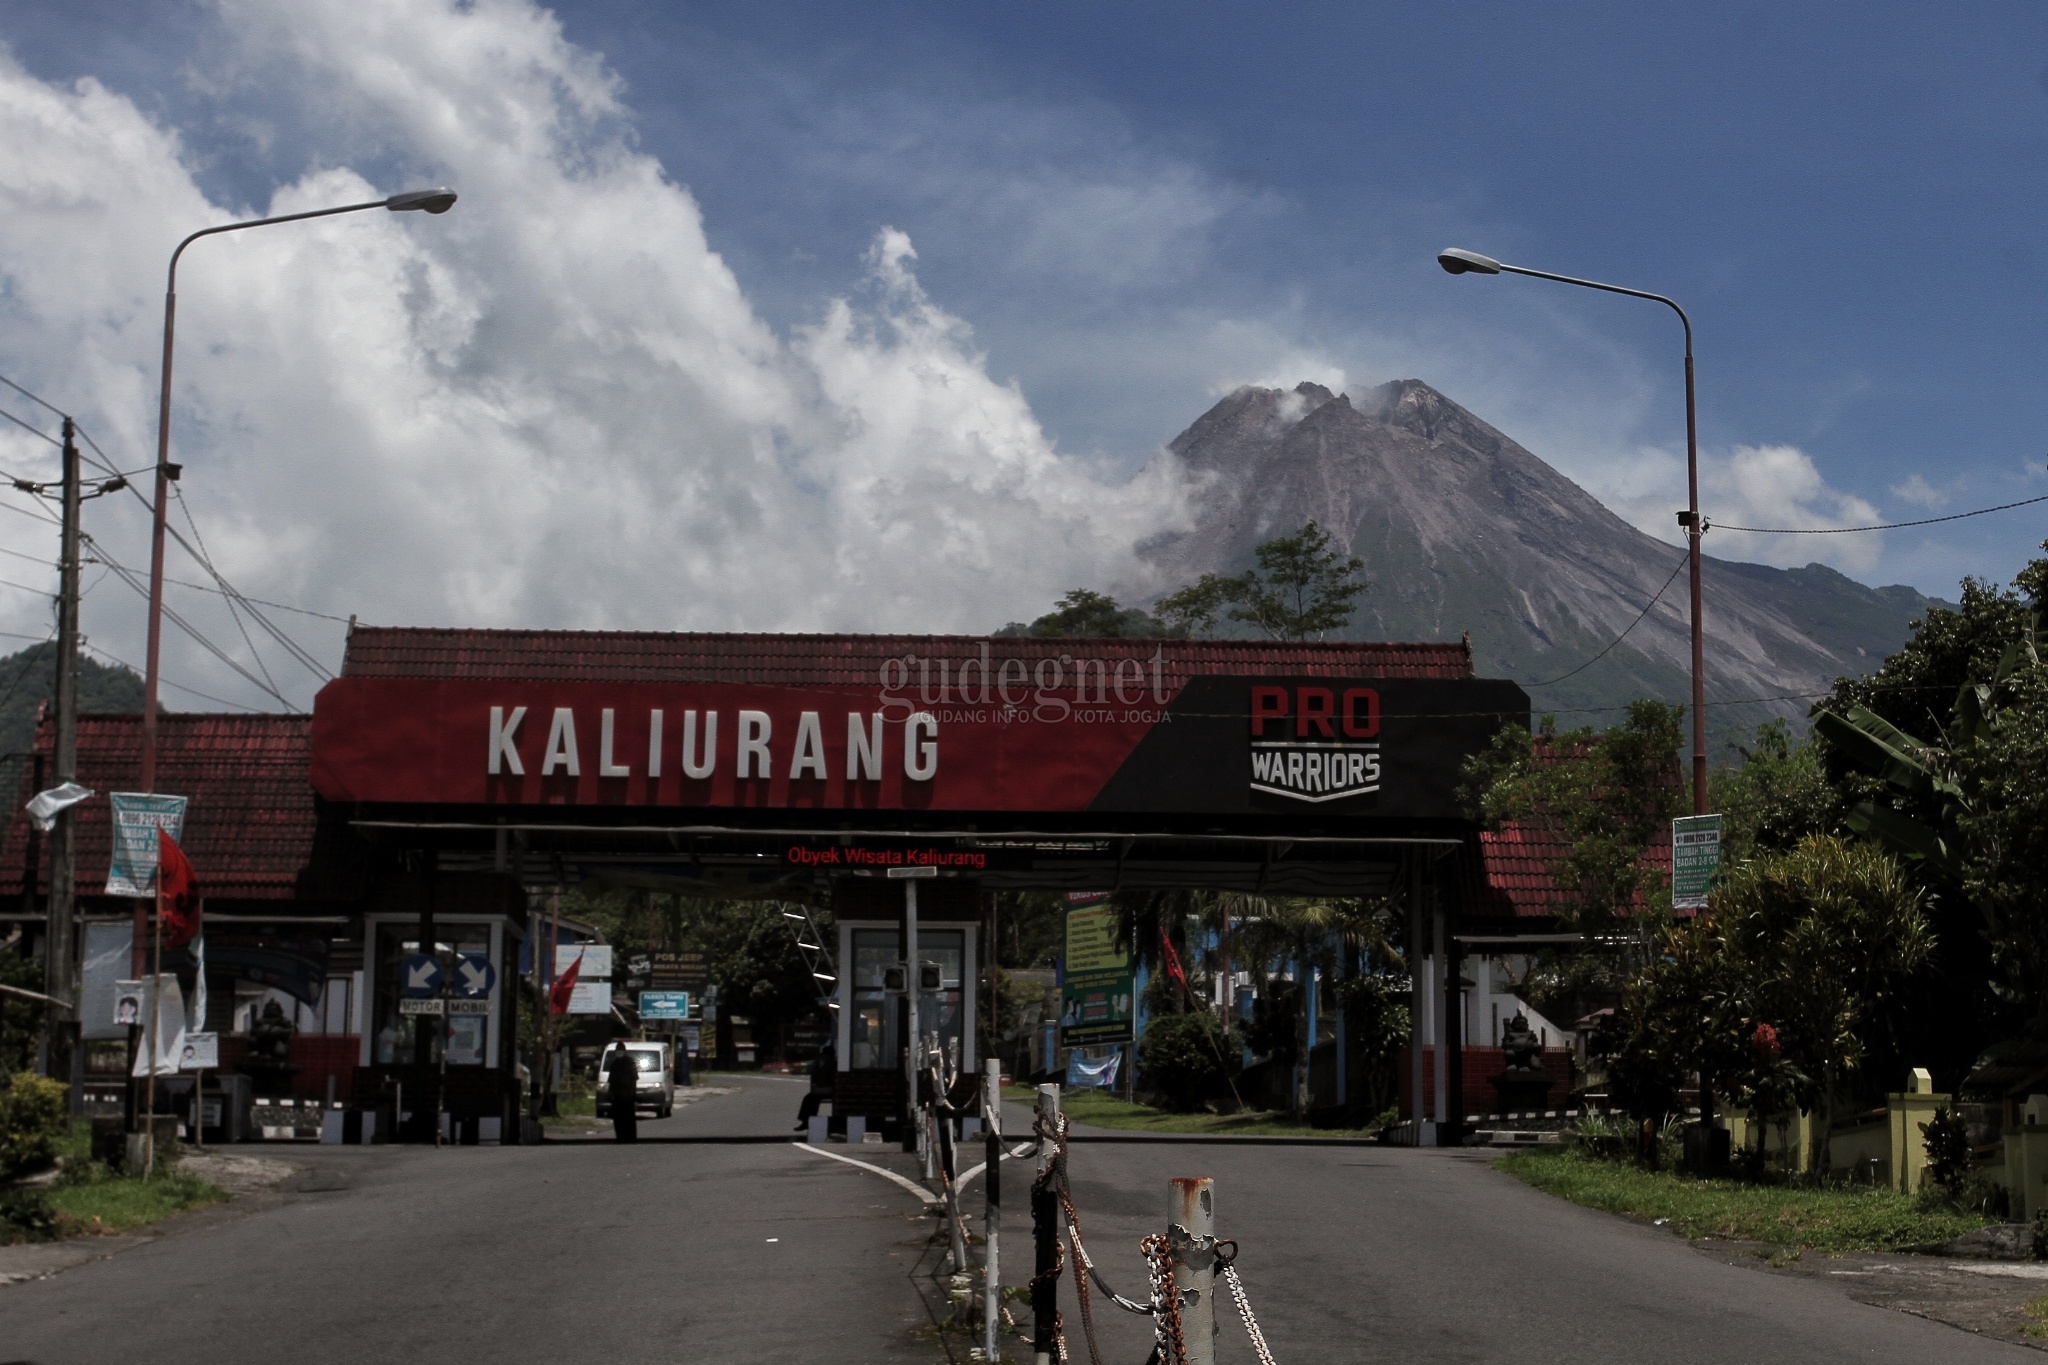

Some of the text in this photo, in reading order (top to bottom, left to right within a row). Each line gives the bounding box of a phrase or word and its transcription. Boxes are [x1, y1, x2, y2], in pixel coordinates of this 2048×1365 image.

[1250, 686, 1380, 739] PRO
[487, 706, 939, 782] KALIURANG
[1250, 752, 1380, 792] WARRIORS
[788, 846, 986, 868] Obyek Wisata Kaliurang
[1676, 845, 1719, 857] TAMBAH TINGGI
[1676, 855, 1719, 867] BADAN 2-8 CM
[655, 953, 704, 961] POS JEEP
[402, 1001, 488, 1012] MOTOR MOBIL
